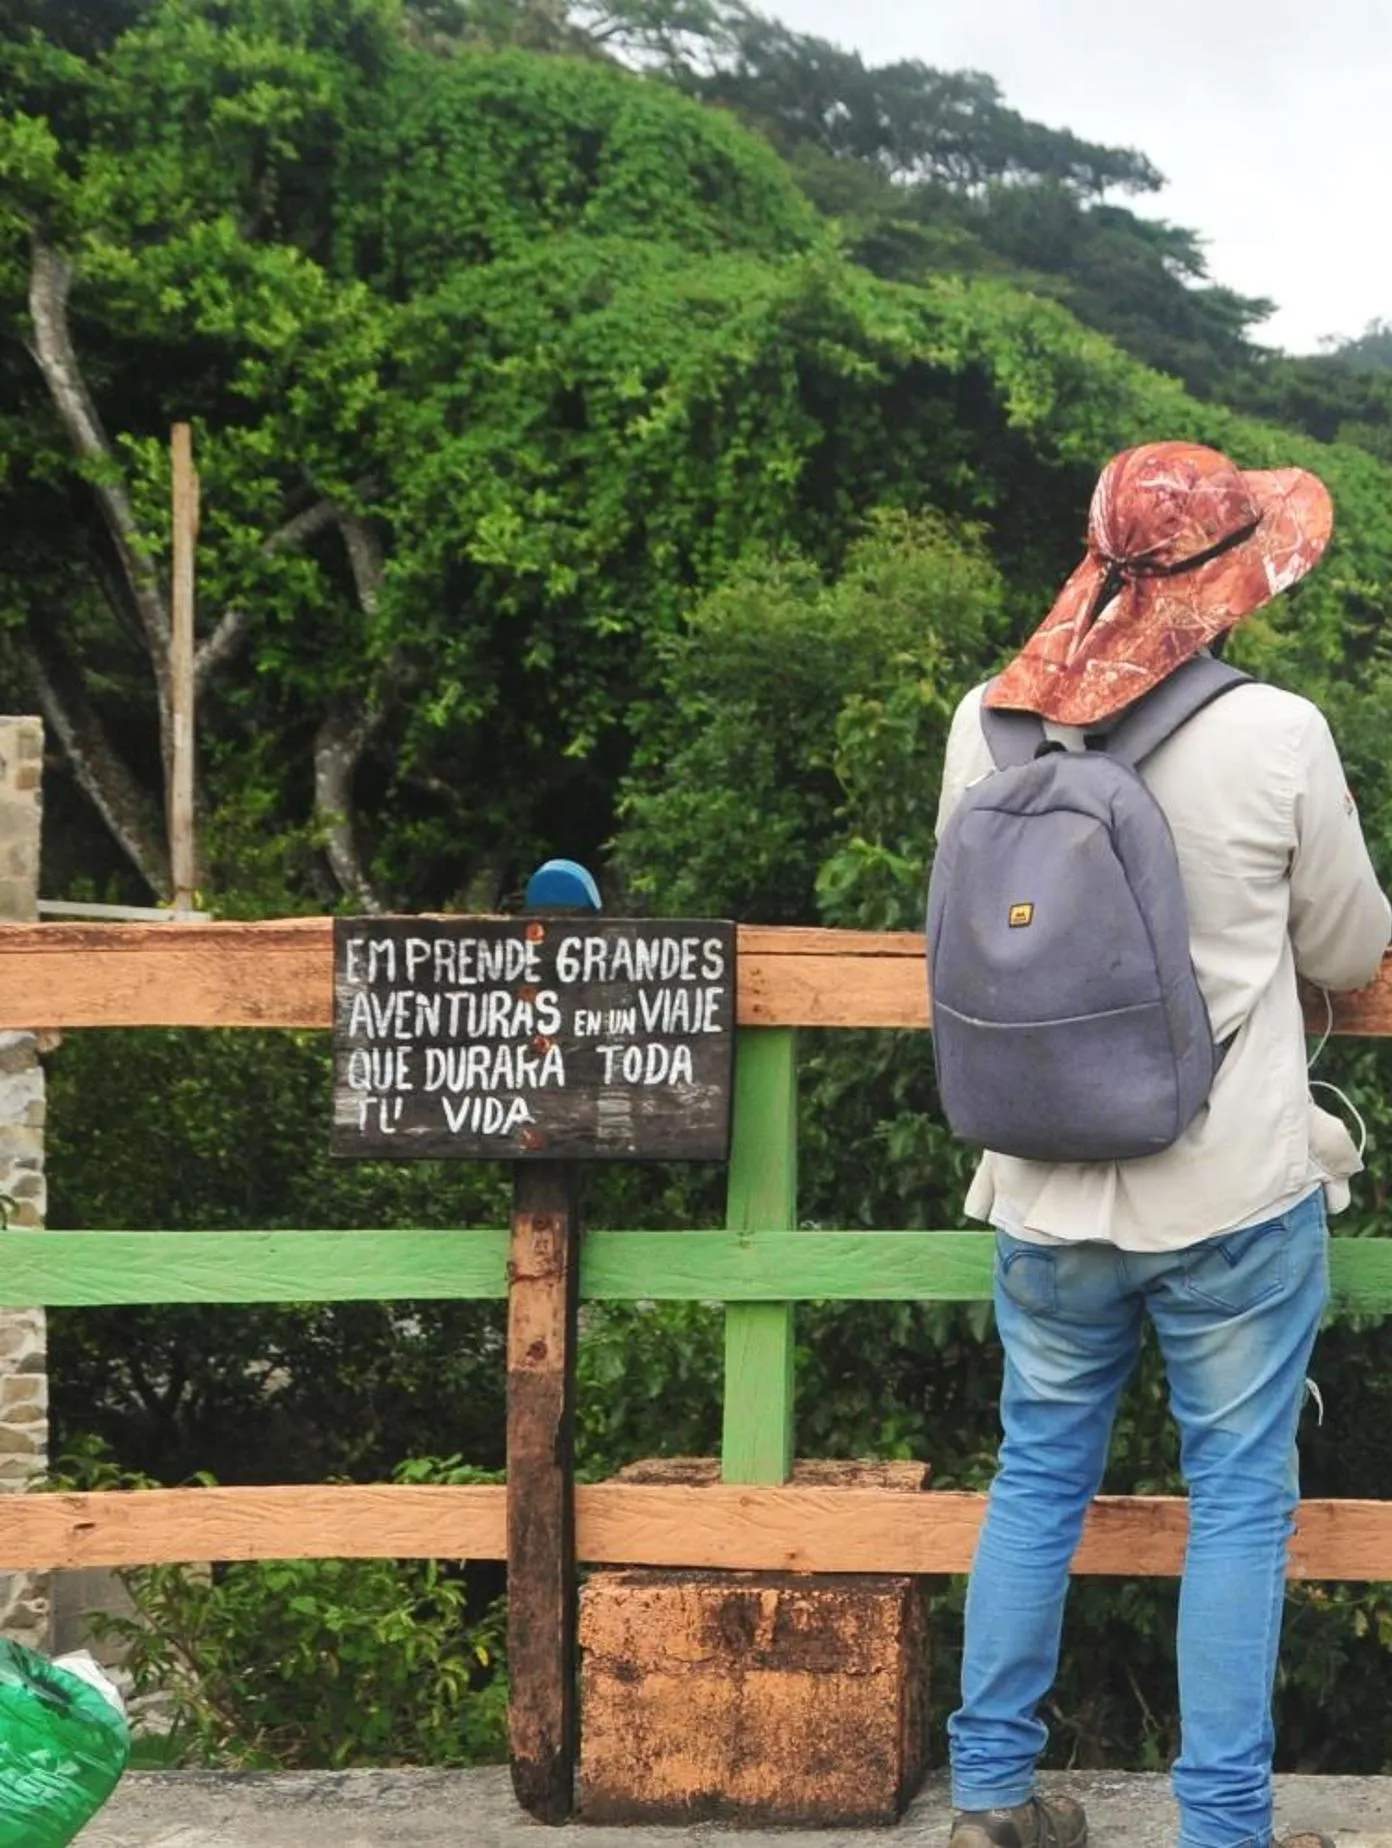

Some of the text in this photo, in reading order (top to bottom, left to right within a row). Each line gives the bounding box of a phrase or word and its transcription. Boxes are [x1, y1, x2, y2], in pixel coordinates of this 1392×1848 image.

[346, 936, 725, 985] EMPRENDE GRANDES
[349, 986, 724, 1040] AVENTURAS EN UN VIAJE
[348, 1046, 413, 1091] QUE
[595, 1042, 694, 1086] TODA
[357, 1095, 536, 1135] TU VIDA
